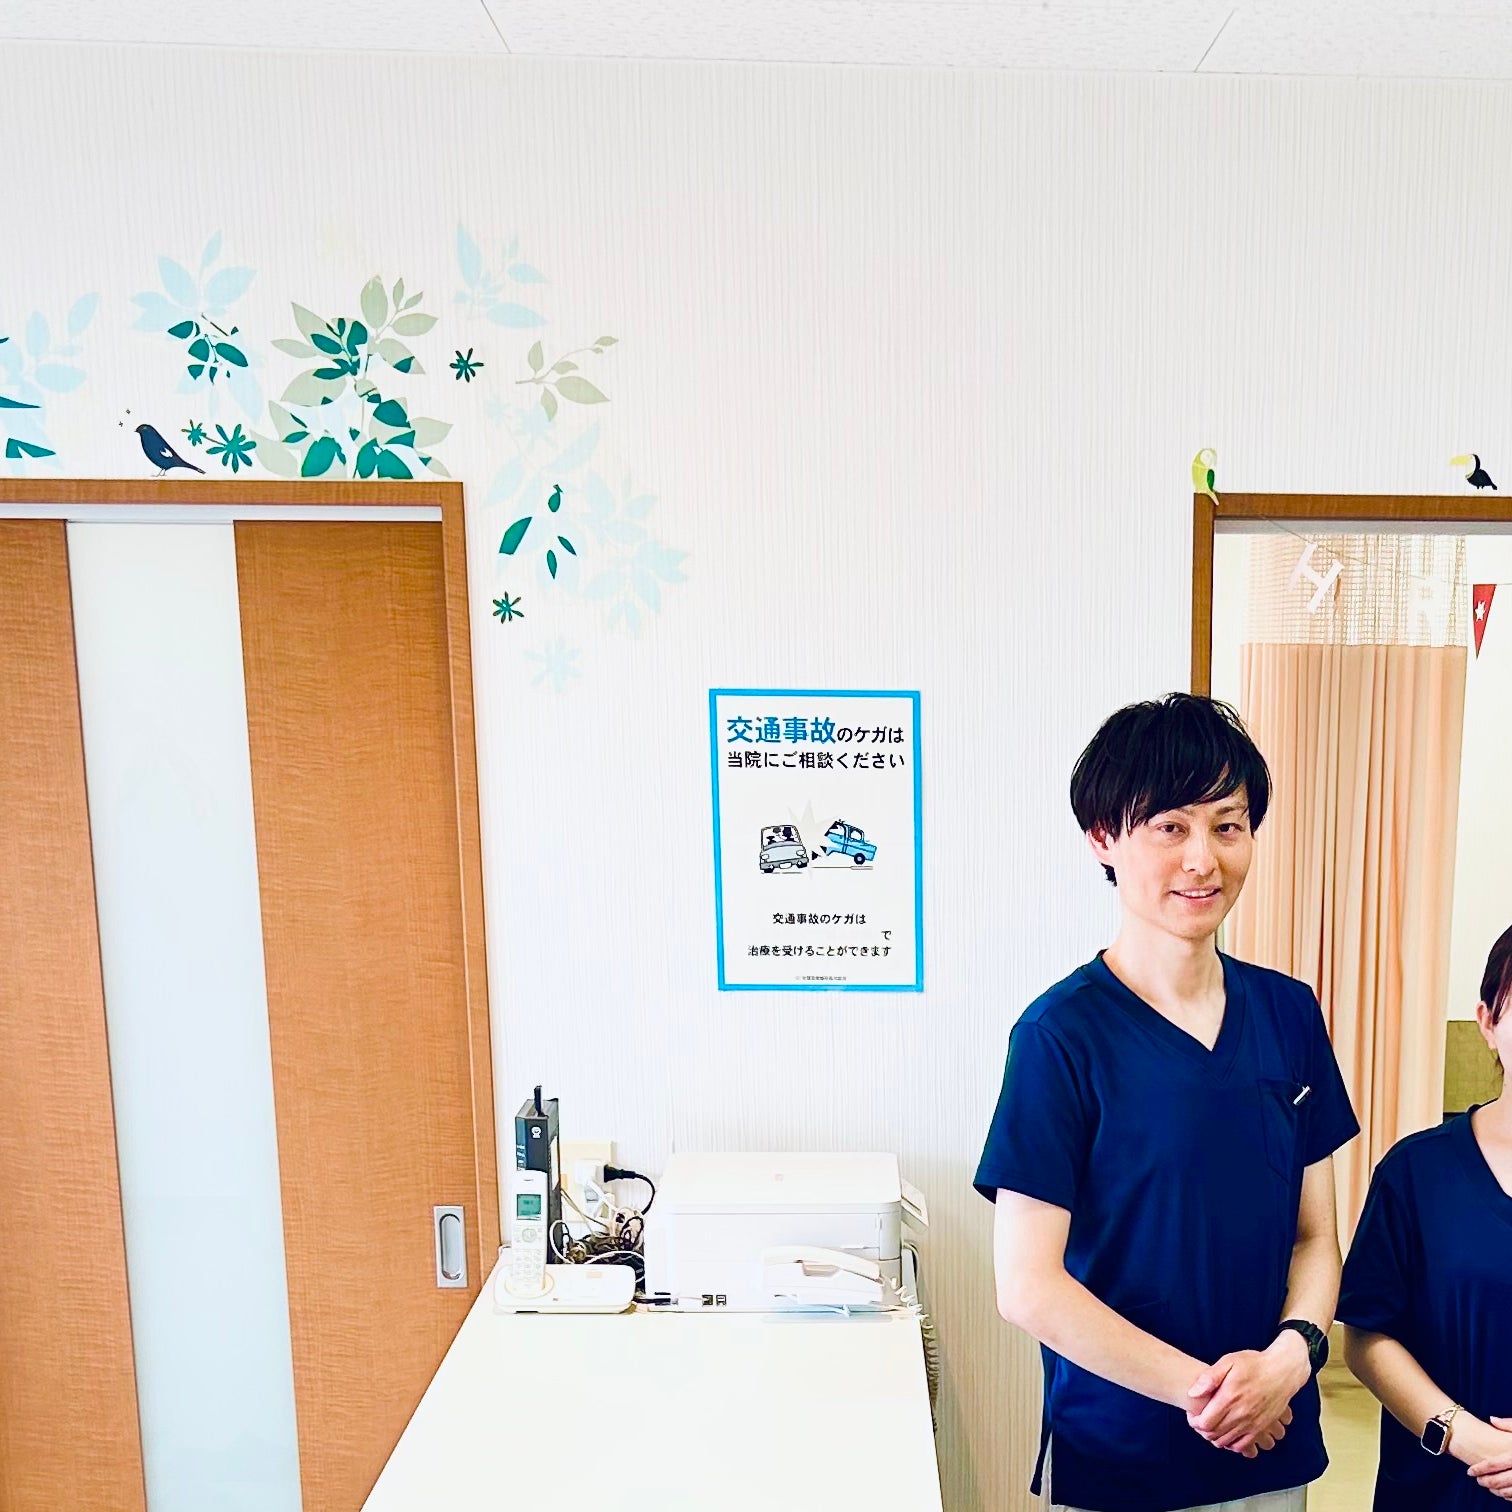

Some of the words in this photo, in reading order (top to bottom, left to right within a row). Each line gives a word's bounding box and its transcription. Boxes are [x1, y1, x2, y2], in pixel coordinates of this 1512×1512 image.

[726, 716, 905, 744] 交通事故のケガは
[727, 751, 905, 769] 当院にご相談ください
[772, 913, 867, 925] 交通事故のケガは
[748, 945, 892, 957] 治療を受けることができます
